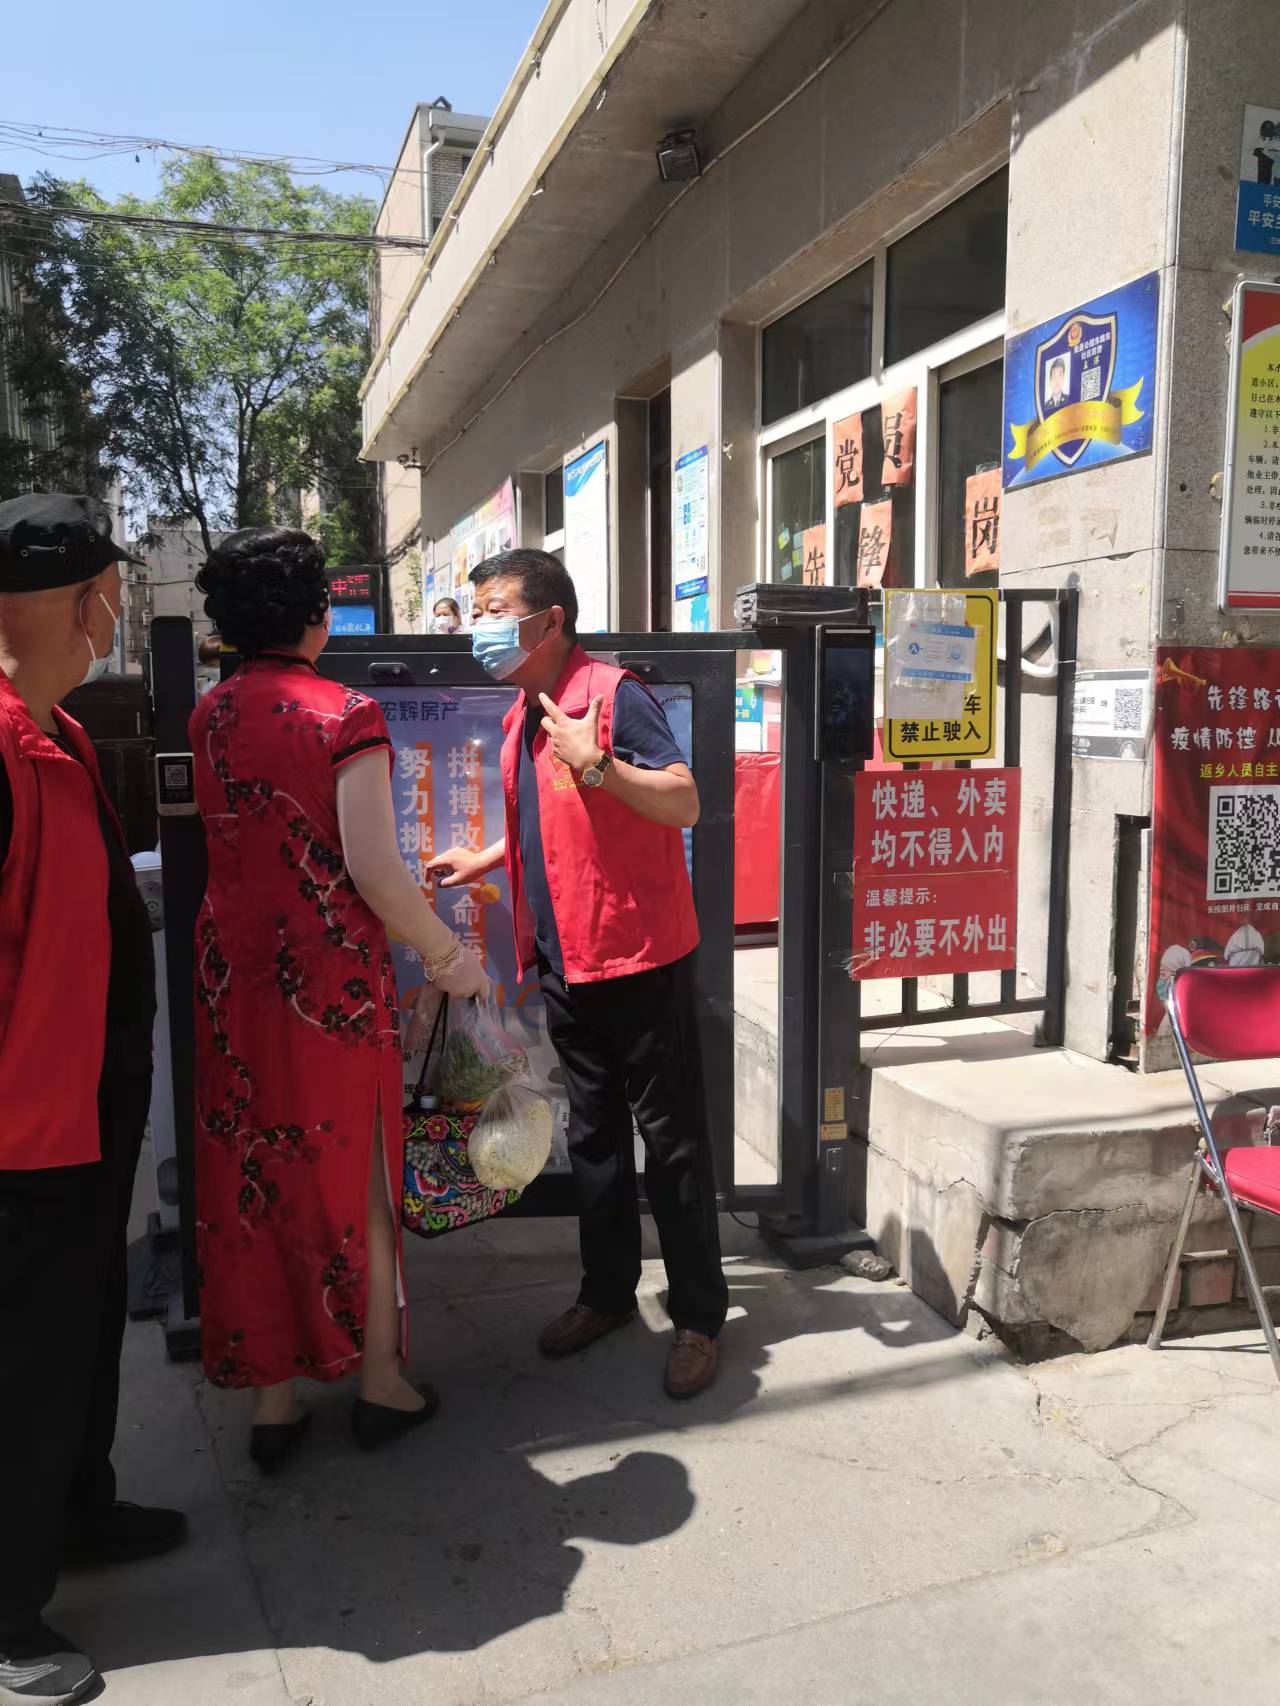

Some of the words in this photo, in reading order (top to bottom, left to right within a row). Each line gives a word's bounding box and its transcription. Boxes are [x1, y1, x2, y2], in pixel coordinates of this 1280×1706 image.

[836, 439, 860, 493] 党
[884, 412, 904, 469] 员
[972, 496, 1000, 559] 岗
[964, 695, 982, 716] 车
[900, 721, 982, 743] 禁止驶入
[1171, 726, 1257, 751] 疫情防控
[1200, 762, 1279, 778] 返乡人员自主
[448, 745, 485, 961] 拼搏改命运
[871, 825, 1004, 868] 均不得入内
[863, 913, 1008, 961] 非必要不外出
